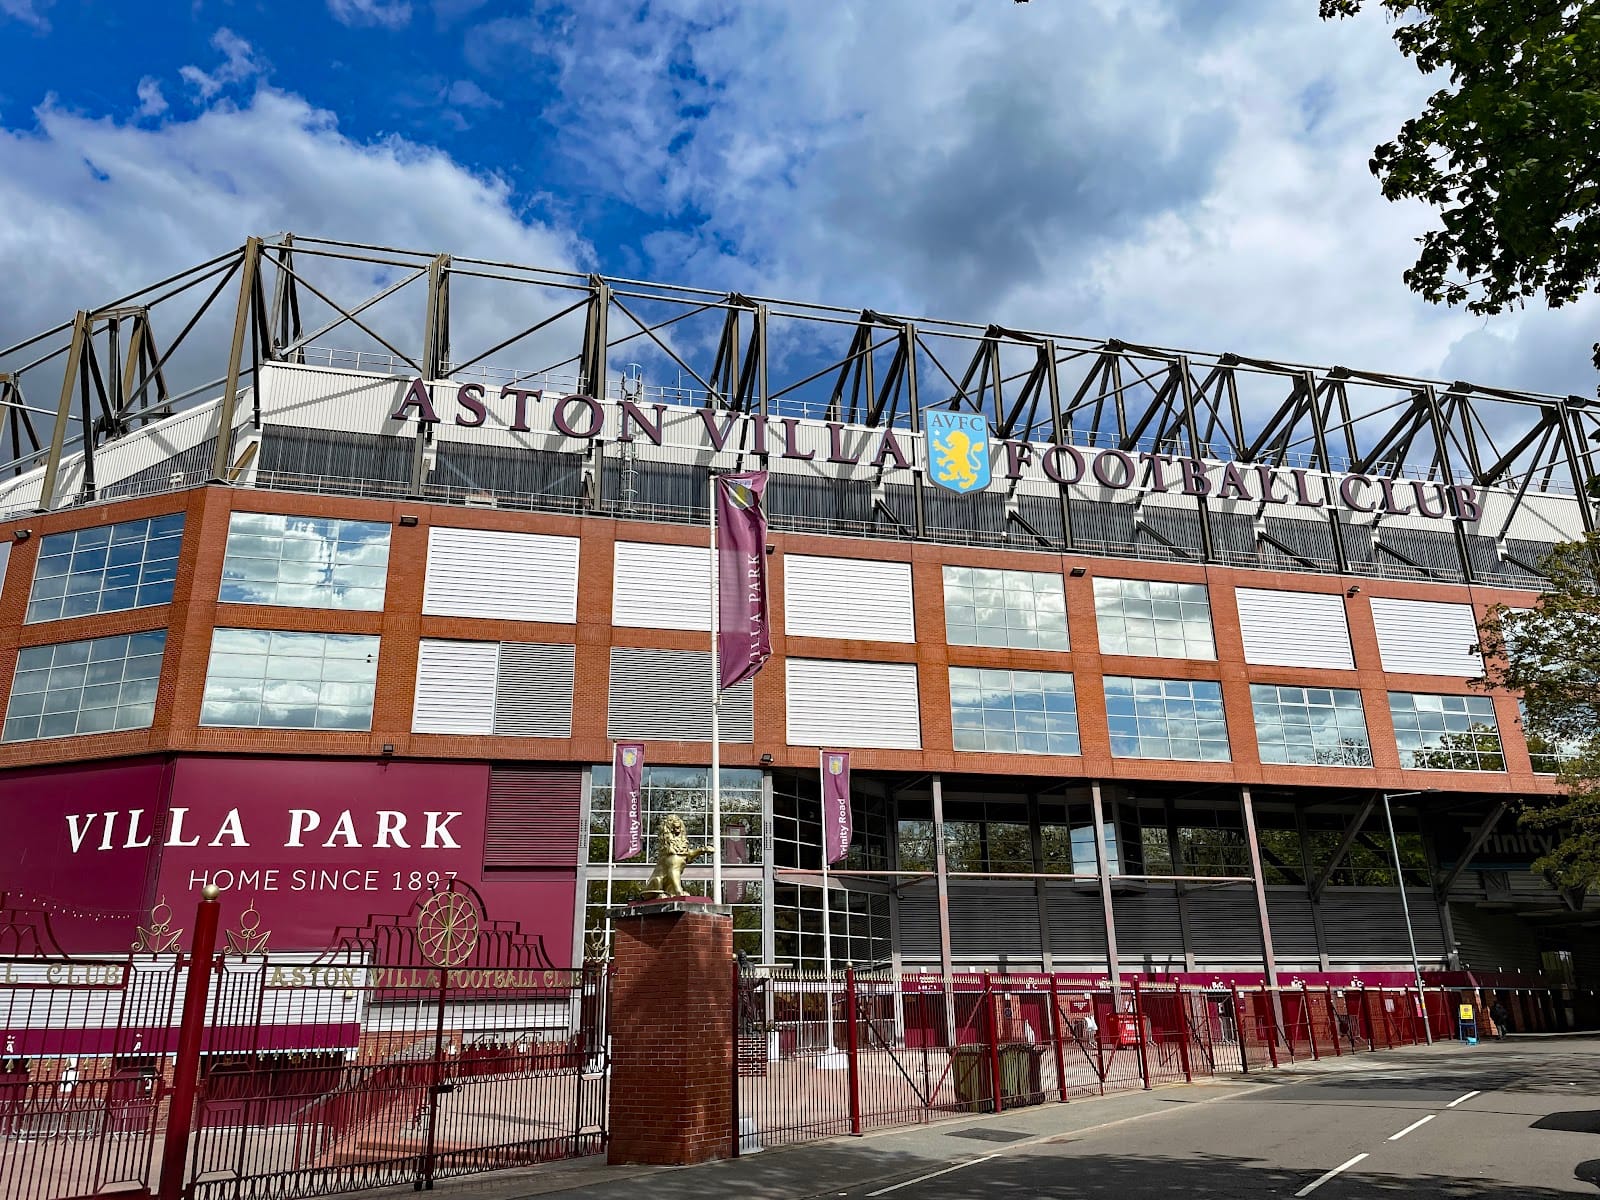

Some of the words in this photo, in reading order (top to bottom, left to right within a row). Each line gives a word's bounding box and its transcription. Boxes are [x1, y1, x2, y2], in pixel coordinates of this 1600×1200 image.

[931, 413, 984, 432] AVFC
[391, 377, 666, 446] ASTON
[697, 407, 912, 469] VILLA
[1005, 441, 1325, 507] FOOTBALL
[1339, 473, 1484, 522] CLUB
[747, 553, 762, 604] PARK
[628, 791, 639, 818] Road
[837, 798, 848, 824] Road
[65, 807, 251, 854] VILLA
[284, 808, 464, 849] PARK
[628, 819, 641, 854] Trinity
[838, 825, 849, 857] Trinity
[188, 869, 280, 891] HOME
[290, 869, 379, 891] SINCE
[392, 871, 458, 891] 1897
[47, 963, 120, 986] CLUB
[270, 965, 358, 988] ASTON
[369, 967, 441, 989] VILLA
[446, 969, 538, 989] FOOTBALL
